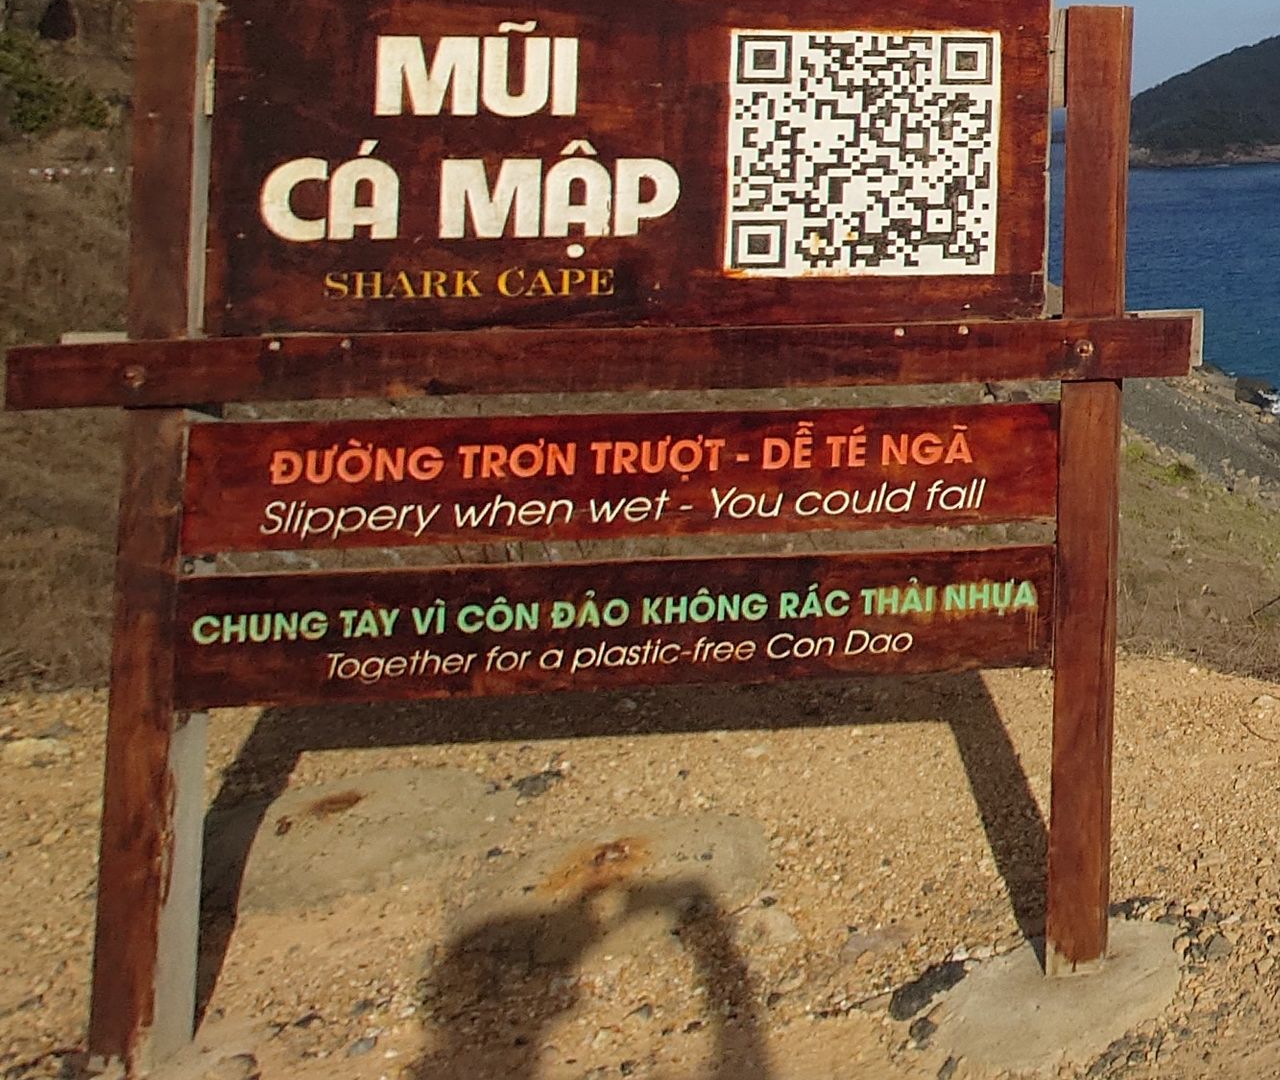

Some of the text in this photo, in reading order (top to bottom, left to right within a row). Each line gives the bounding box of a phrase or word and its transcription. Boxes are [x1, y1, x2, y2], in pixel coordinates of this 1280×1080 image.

[373, 20, 579, 118] MŨI
[259, 139, 681, 259] CÁ MẬP
[323, 266, 616, 300] SHARK CAPE
[269, 438, 445, 485] ĐƯỜNG
[457, 437, 578, 479] TRƠN
[590, 433, 726, 482] TRƯỢT
[762, 420, 814, 470] DỄ
[825, 424, 868, 468] TÉ
[881, 423, 974, 466] NGÃ
[259, 499, 441, 540] Slippery
[453, 493, 573, 528] when
[589, 488, 670, 523] wet
[710, 487, 784, 520] You
[795, 480, 917, 516] could
[925, 477, 987, 512] fall
[192, 576, 1038, 646] CHUNG TAY VÌ CÔN ĐẢO KHÔNG RÁC THẢI NHỰA
[326, 629, 913, 686] Together for a plastic-free Con Dao
